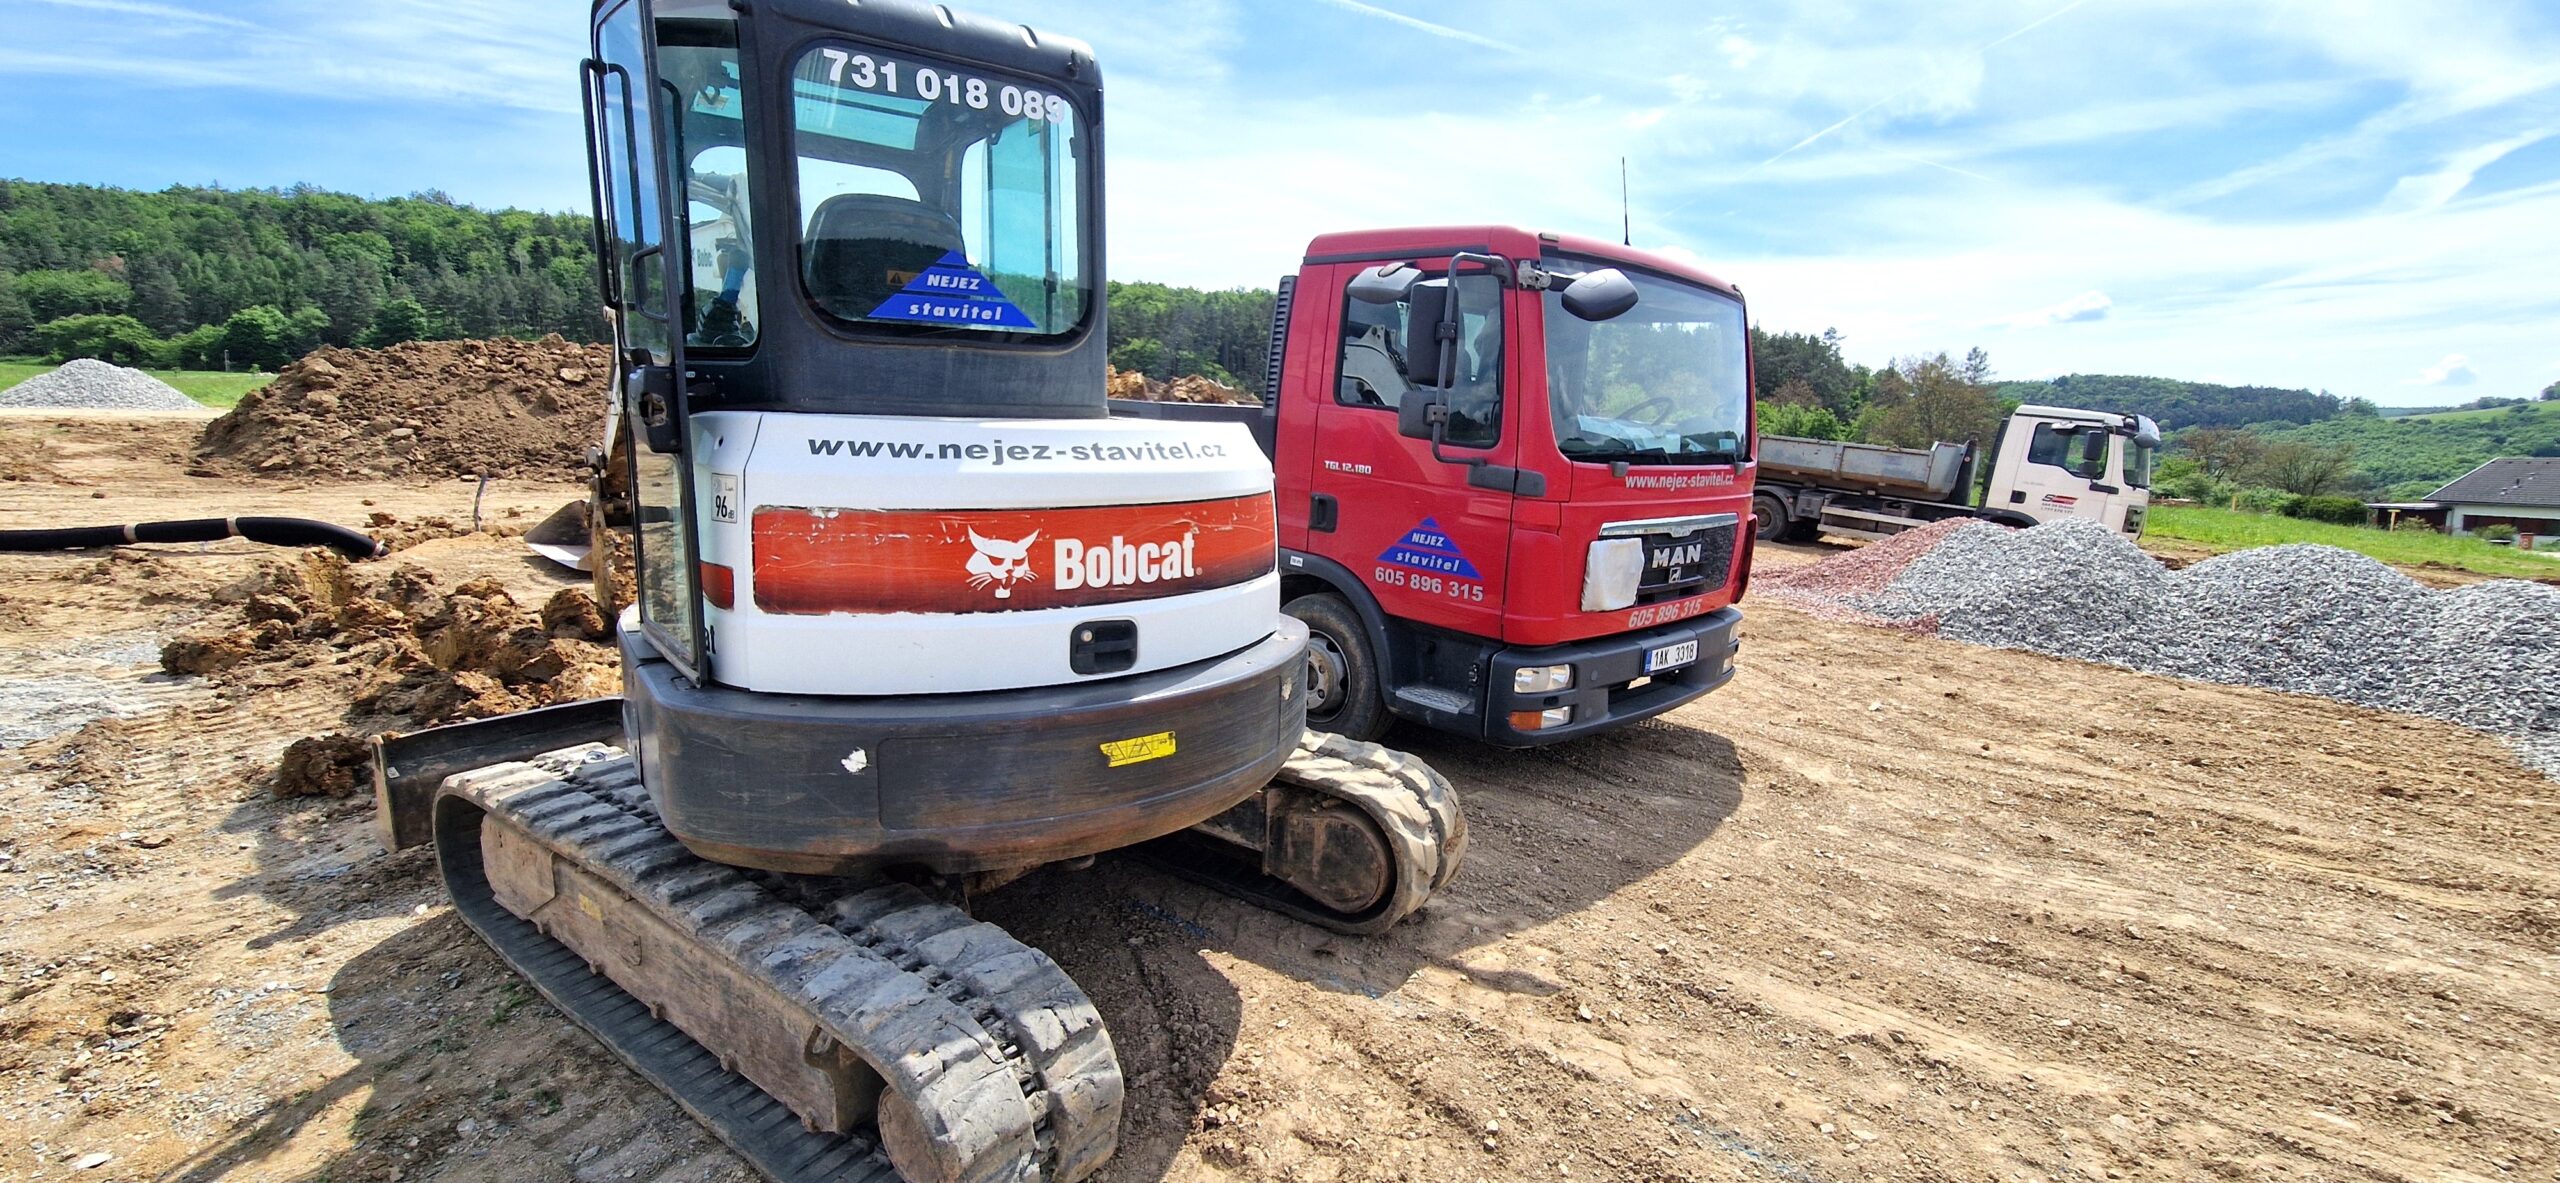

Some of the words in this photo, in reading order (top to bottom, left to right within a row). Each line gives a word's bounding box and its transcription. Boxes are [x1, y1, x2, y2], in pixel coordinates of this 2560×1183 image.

[823, 48, 898, 93] 731
[915, 68, 989, 109] 018
[1000, 85, 1066, 124] 089
[926, 274, 982, 291] NEJEZ
[908, 302, 1003, 321] stavitel
[807, 438, 1227, 466] www.nejez-stavitel.cz
[1323, 460, 1341, 471] TGL
[1625, 471, 1735, 492] www.nejez-stavitel.cz
[715, 494, 728, 518] 96
[1411, 532, 1446, 548] NEJEZ
[1053, 531, 1195, 590] Bobcat
[1395, 551, 1460, 573] stavitel
[1651, 543, 1702, 569] MAN
[1374, 566, 1405, 587] 605
[1409, 573, 1443, 594] 896
[1447, 581, 1484, 602] 315
[1628, 608, 1656, 628] 605
[1655, 603, 1681, 623] 896
[1680, 598, 1703, 617] 315
[1654, 648, 1670, 667] 1AK
[1675, 643, 1695, 663] 3318
